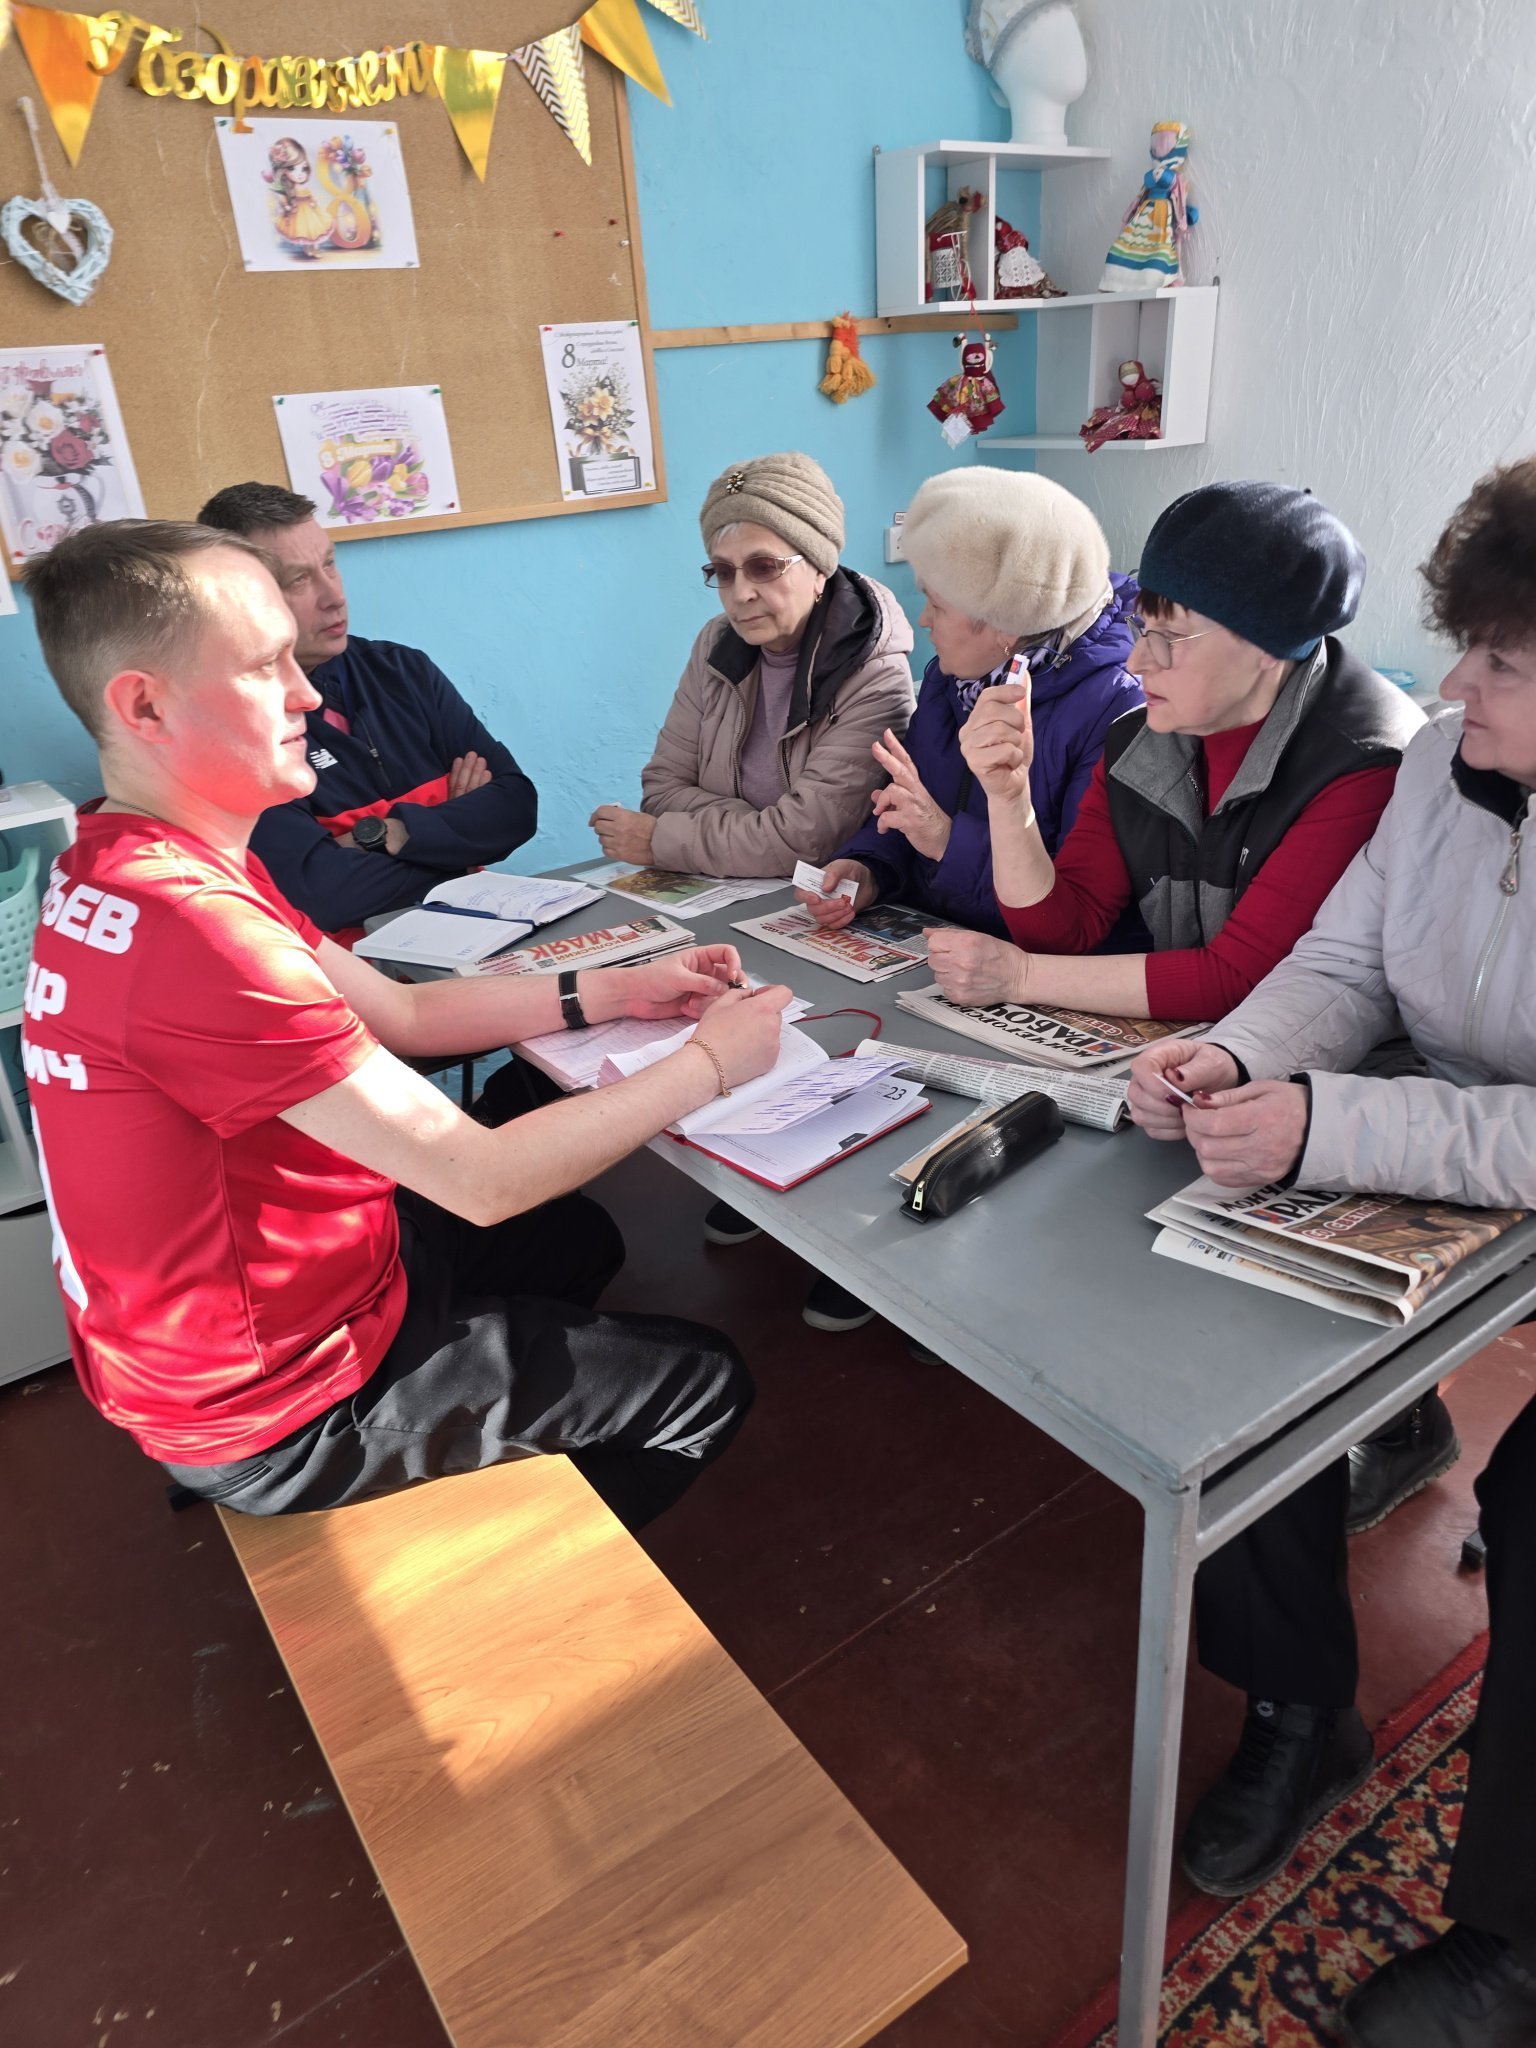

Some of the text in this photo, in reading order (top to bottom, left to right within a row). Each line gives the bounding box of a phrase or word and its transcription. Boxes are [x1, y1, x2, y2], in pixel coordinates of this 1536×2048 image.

[317, 138, 372, 249] 8
[562, 343, 576, 368] 8
[41, 855, 140, 954] ЬЕВ
[527, 928, 615, 961] МАЯК
[555, 937, 620, 961] КОЛЬСКИЙ
[984, 1003, 1101, 1047] РАБОЧ
[883, 1086, 907, 1101] 23
[1214, 1184, 1281, 1212] МОНЧ
[1264, 1189, 1343, 1219] РАБ
